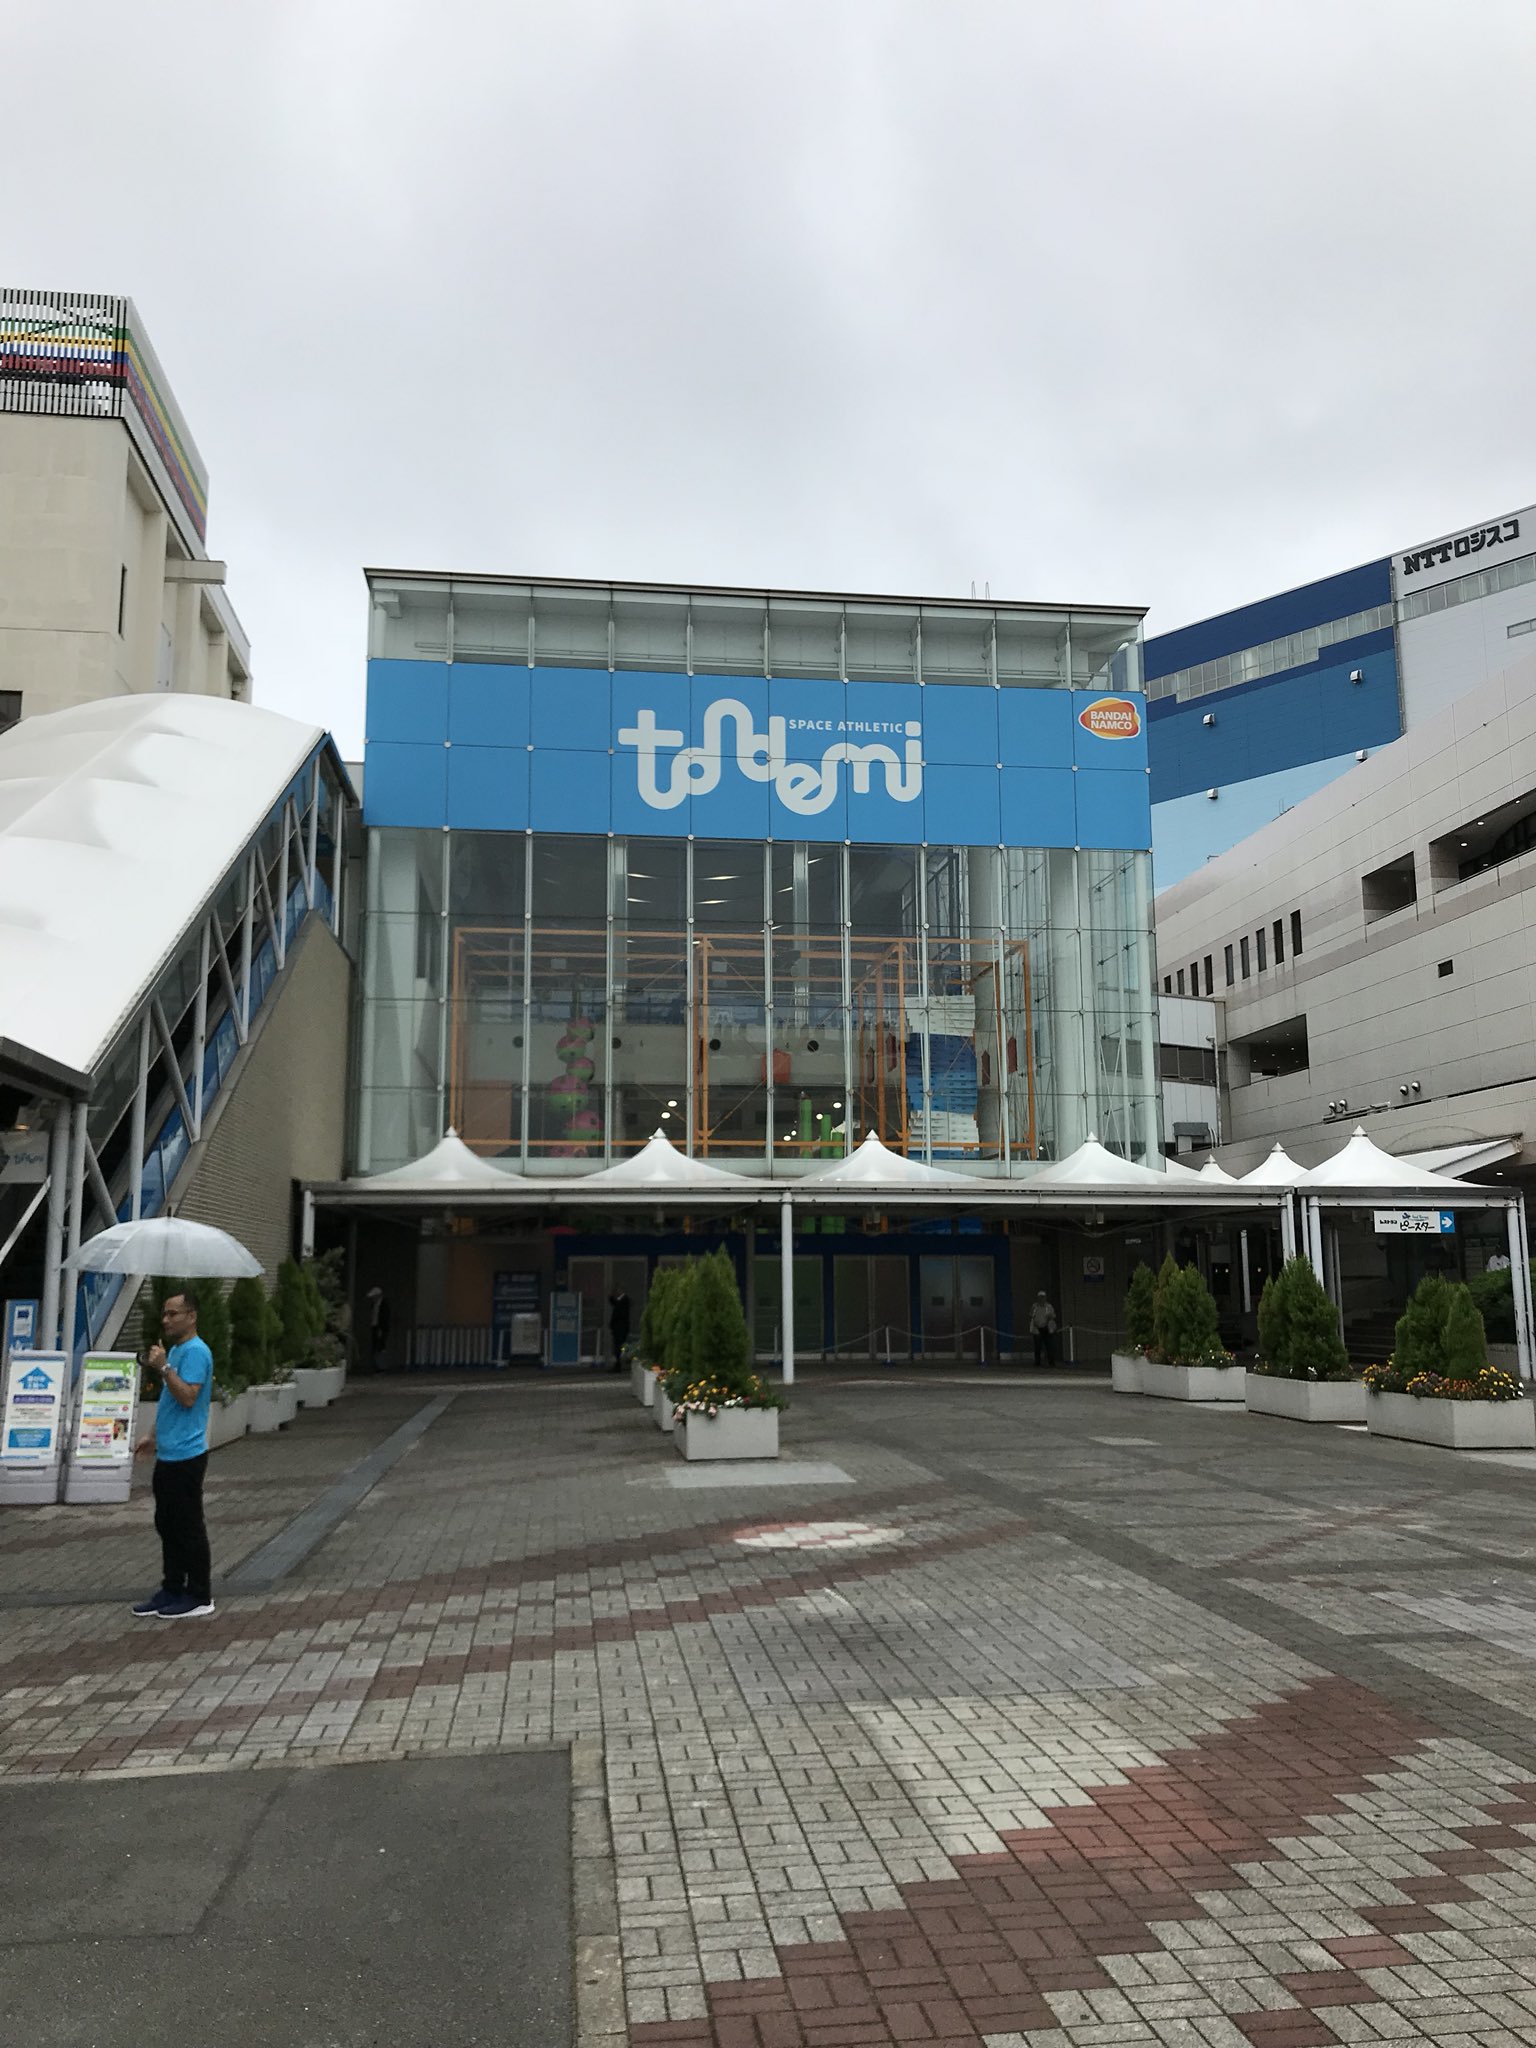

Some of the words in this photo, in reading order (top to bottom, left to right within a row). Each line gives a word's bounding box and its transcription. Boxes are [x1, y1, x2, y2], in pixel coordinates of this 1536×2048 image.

[1403, 519, 1520, 575] NTTロジスコ
[1090, 711, 1132, 721] BANDAI
[788, 718, 832, 731] SPACE
[838, 720, 903, 733] ATHLETIC
[1091, 720, 1132, 730] NAMCO
[1400, 1220, 1435, 1231] ピースター
